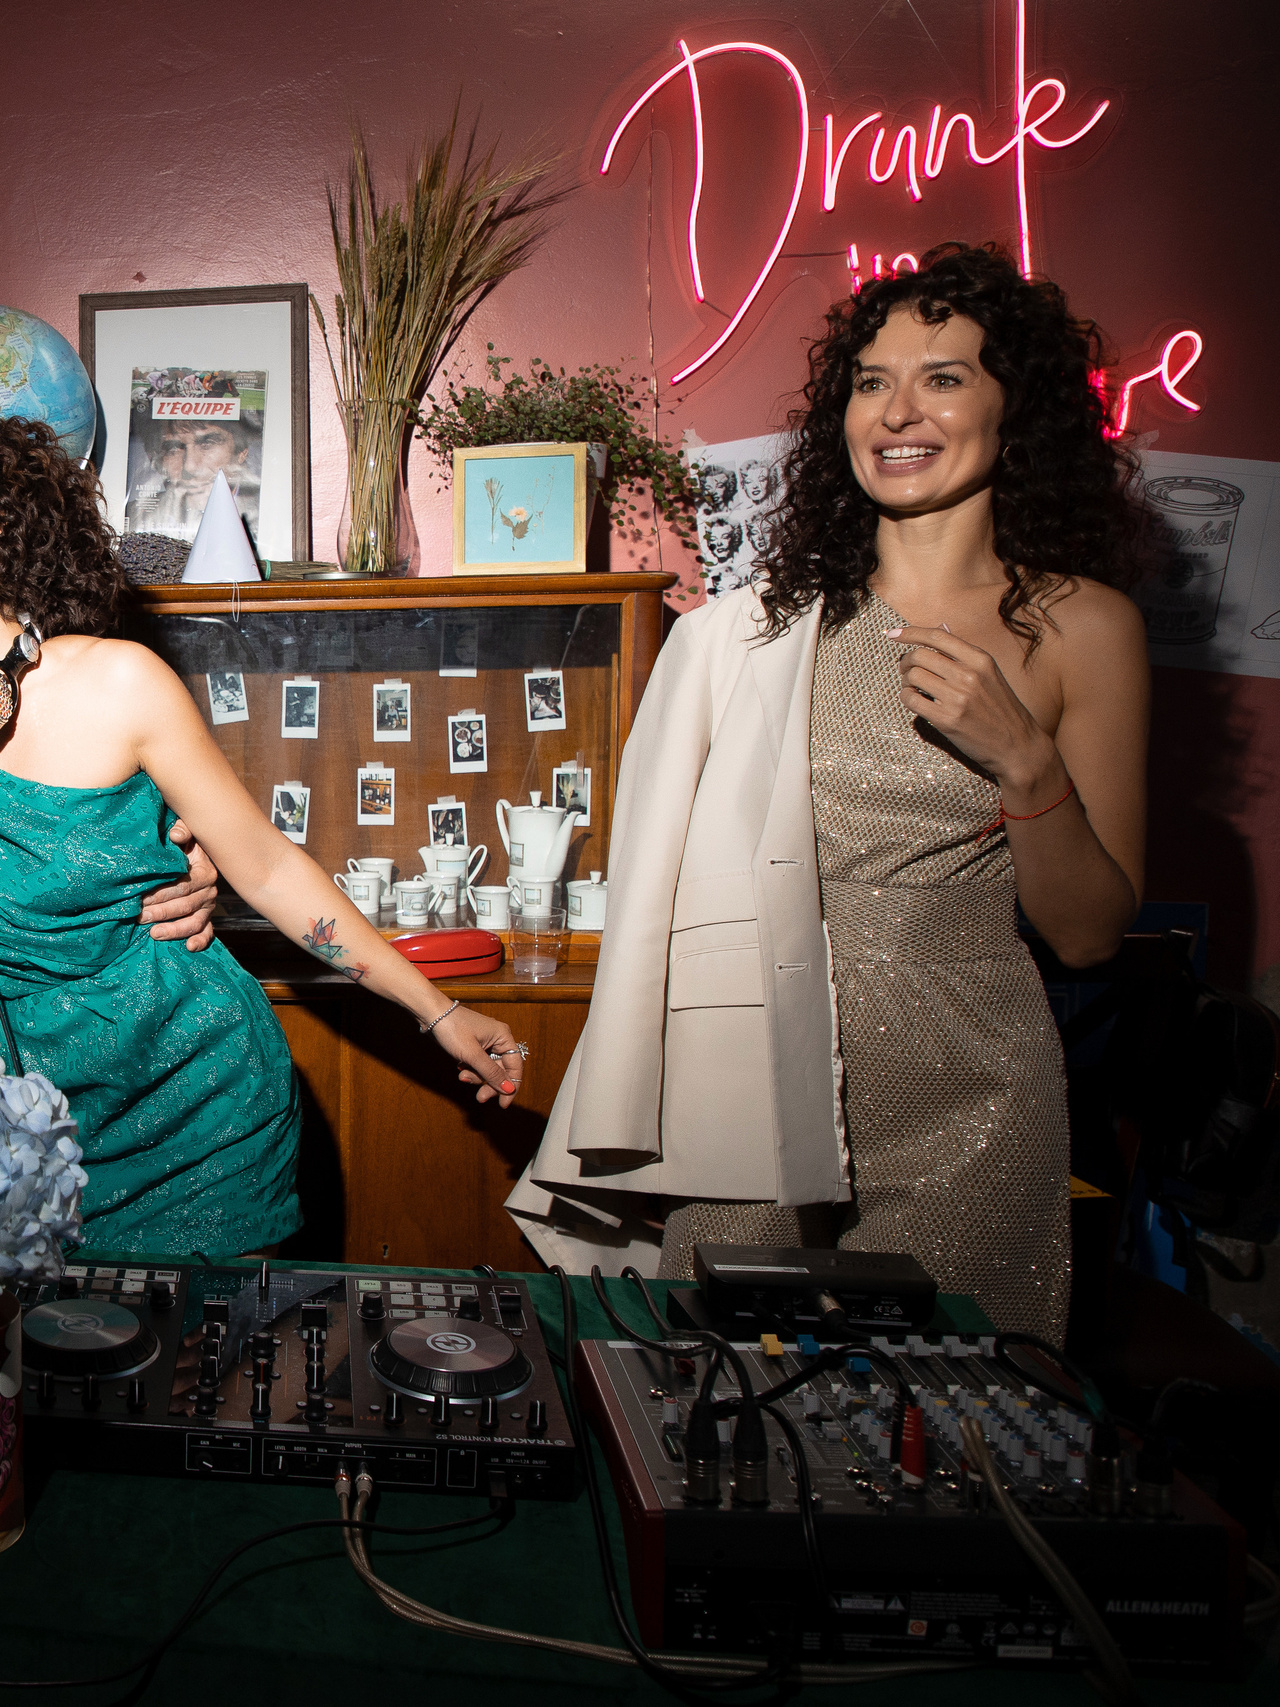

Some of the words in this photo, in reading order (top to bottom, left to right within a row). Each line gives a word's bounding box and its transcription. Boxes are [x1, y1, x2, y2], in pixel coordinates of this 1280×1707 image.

[449, 1433, 491, 1442] KONTROL
[493, 1436, 554, 1446] TRAKTOR
[1106, 1599, 1210, 1616] ALLEN&HEATH
